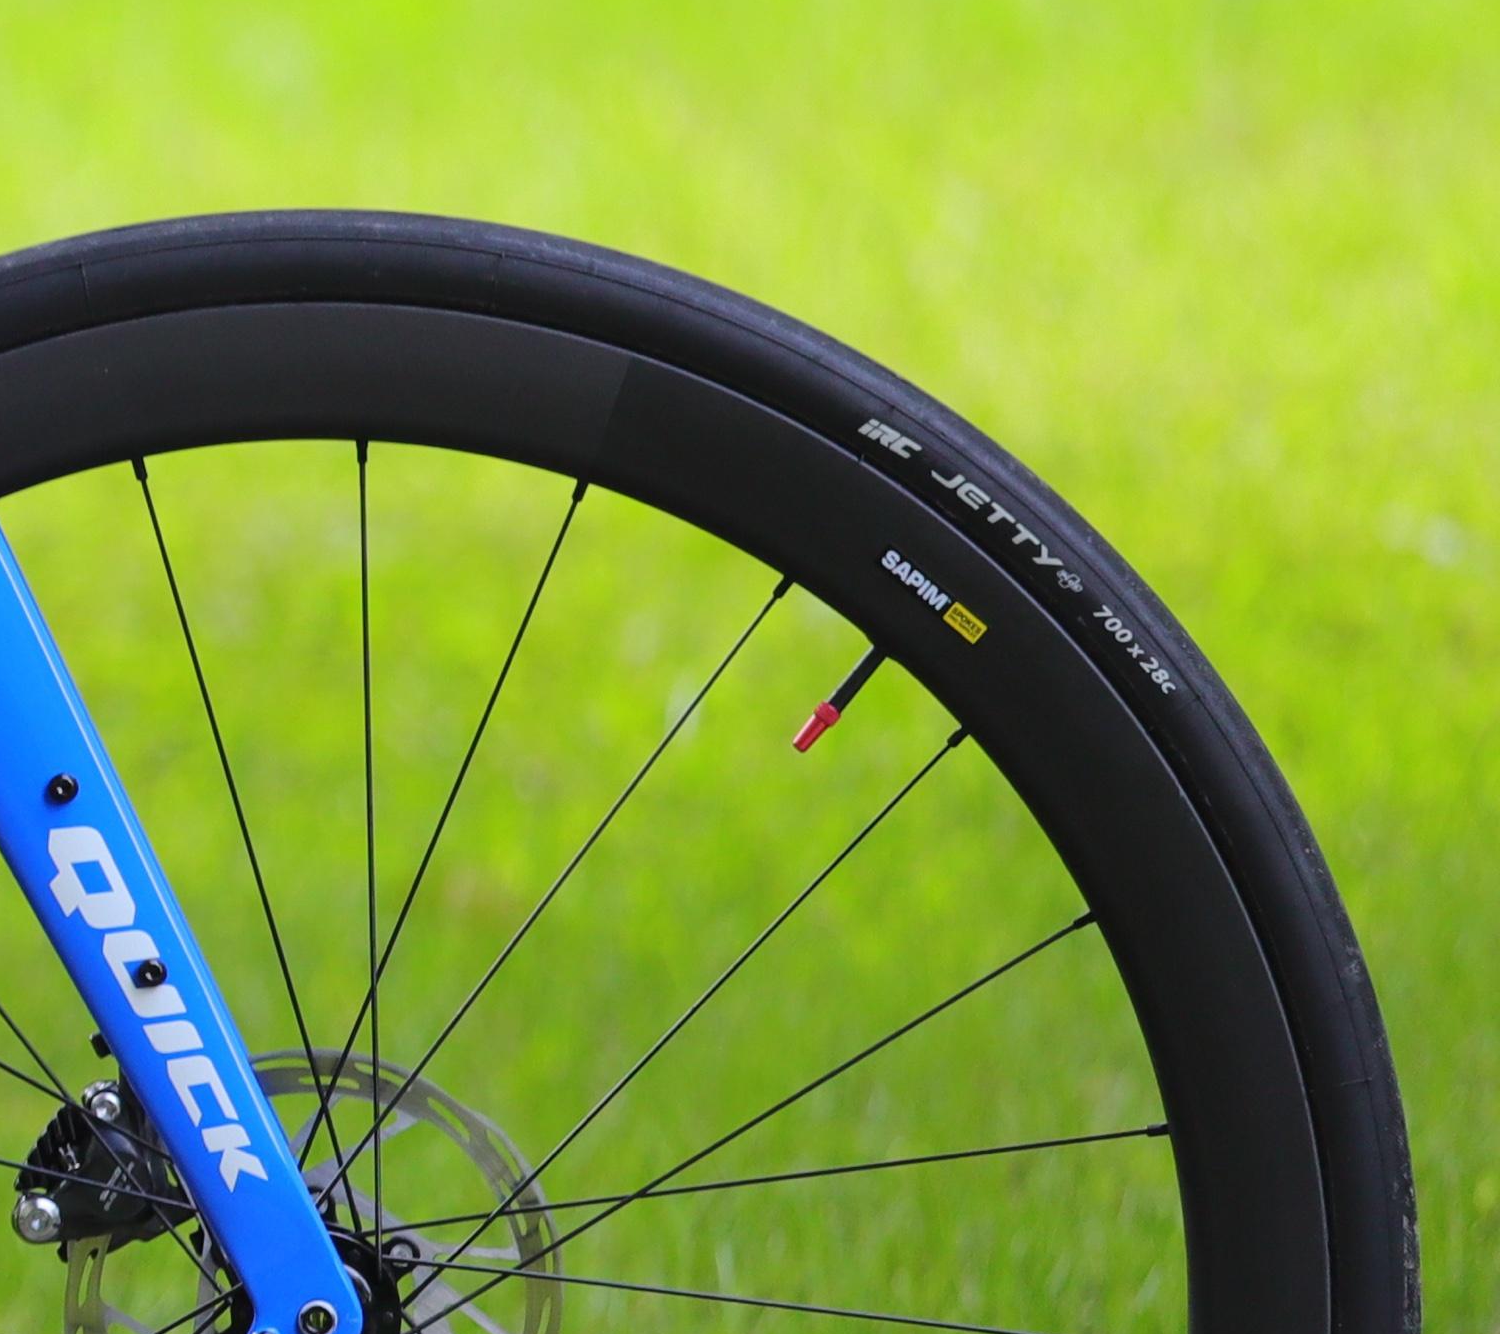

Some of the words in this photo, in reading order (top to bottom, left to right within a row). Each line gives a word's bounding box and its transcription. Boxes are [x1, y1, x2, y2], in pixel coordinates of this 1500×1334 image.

[880, 549, 946, 611] SAPIM
[930, 469, 1064, 567] JETTY
[1092, 604, 1133, 643] 700
[47, 825, 268, 1193] QUICK
